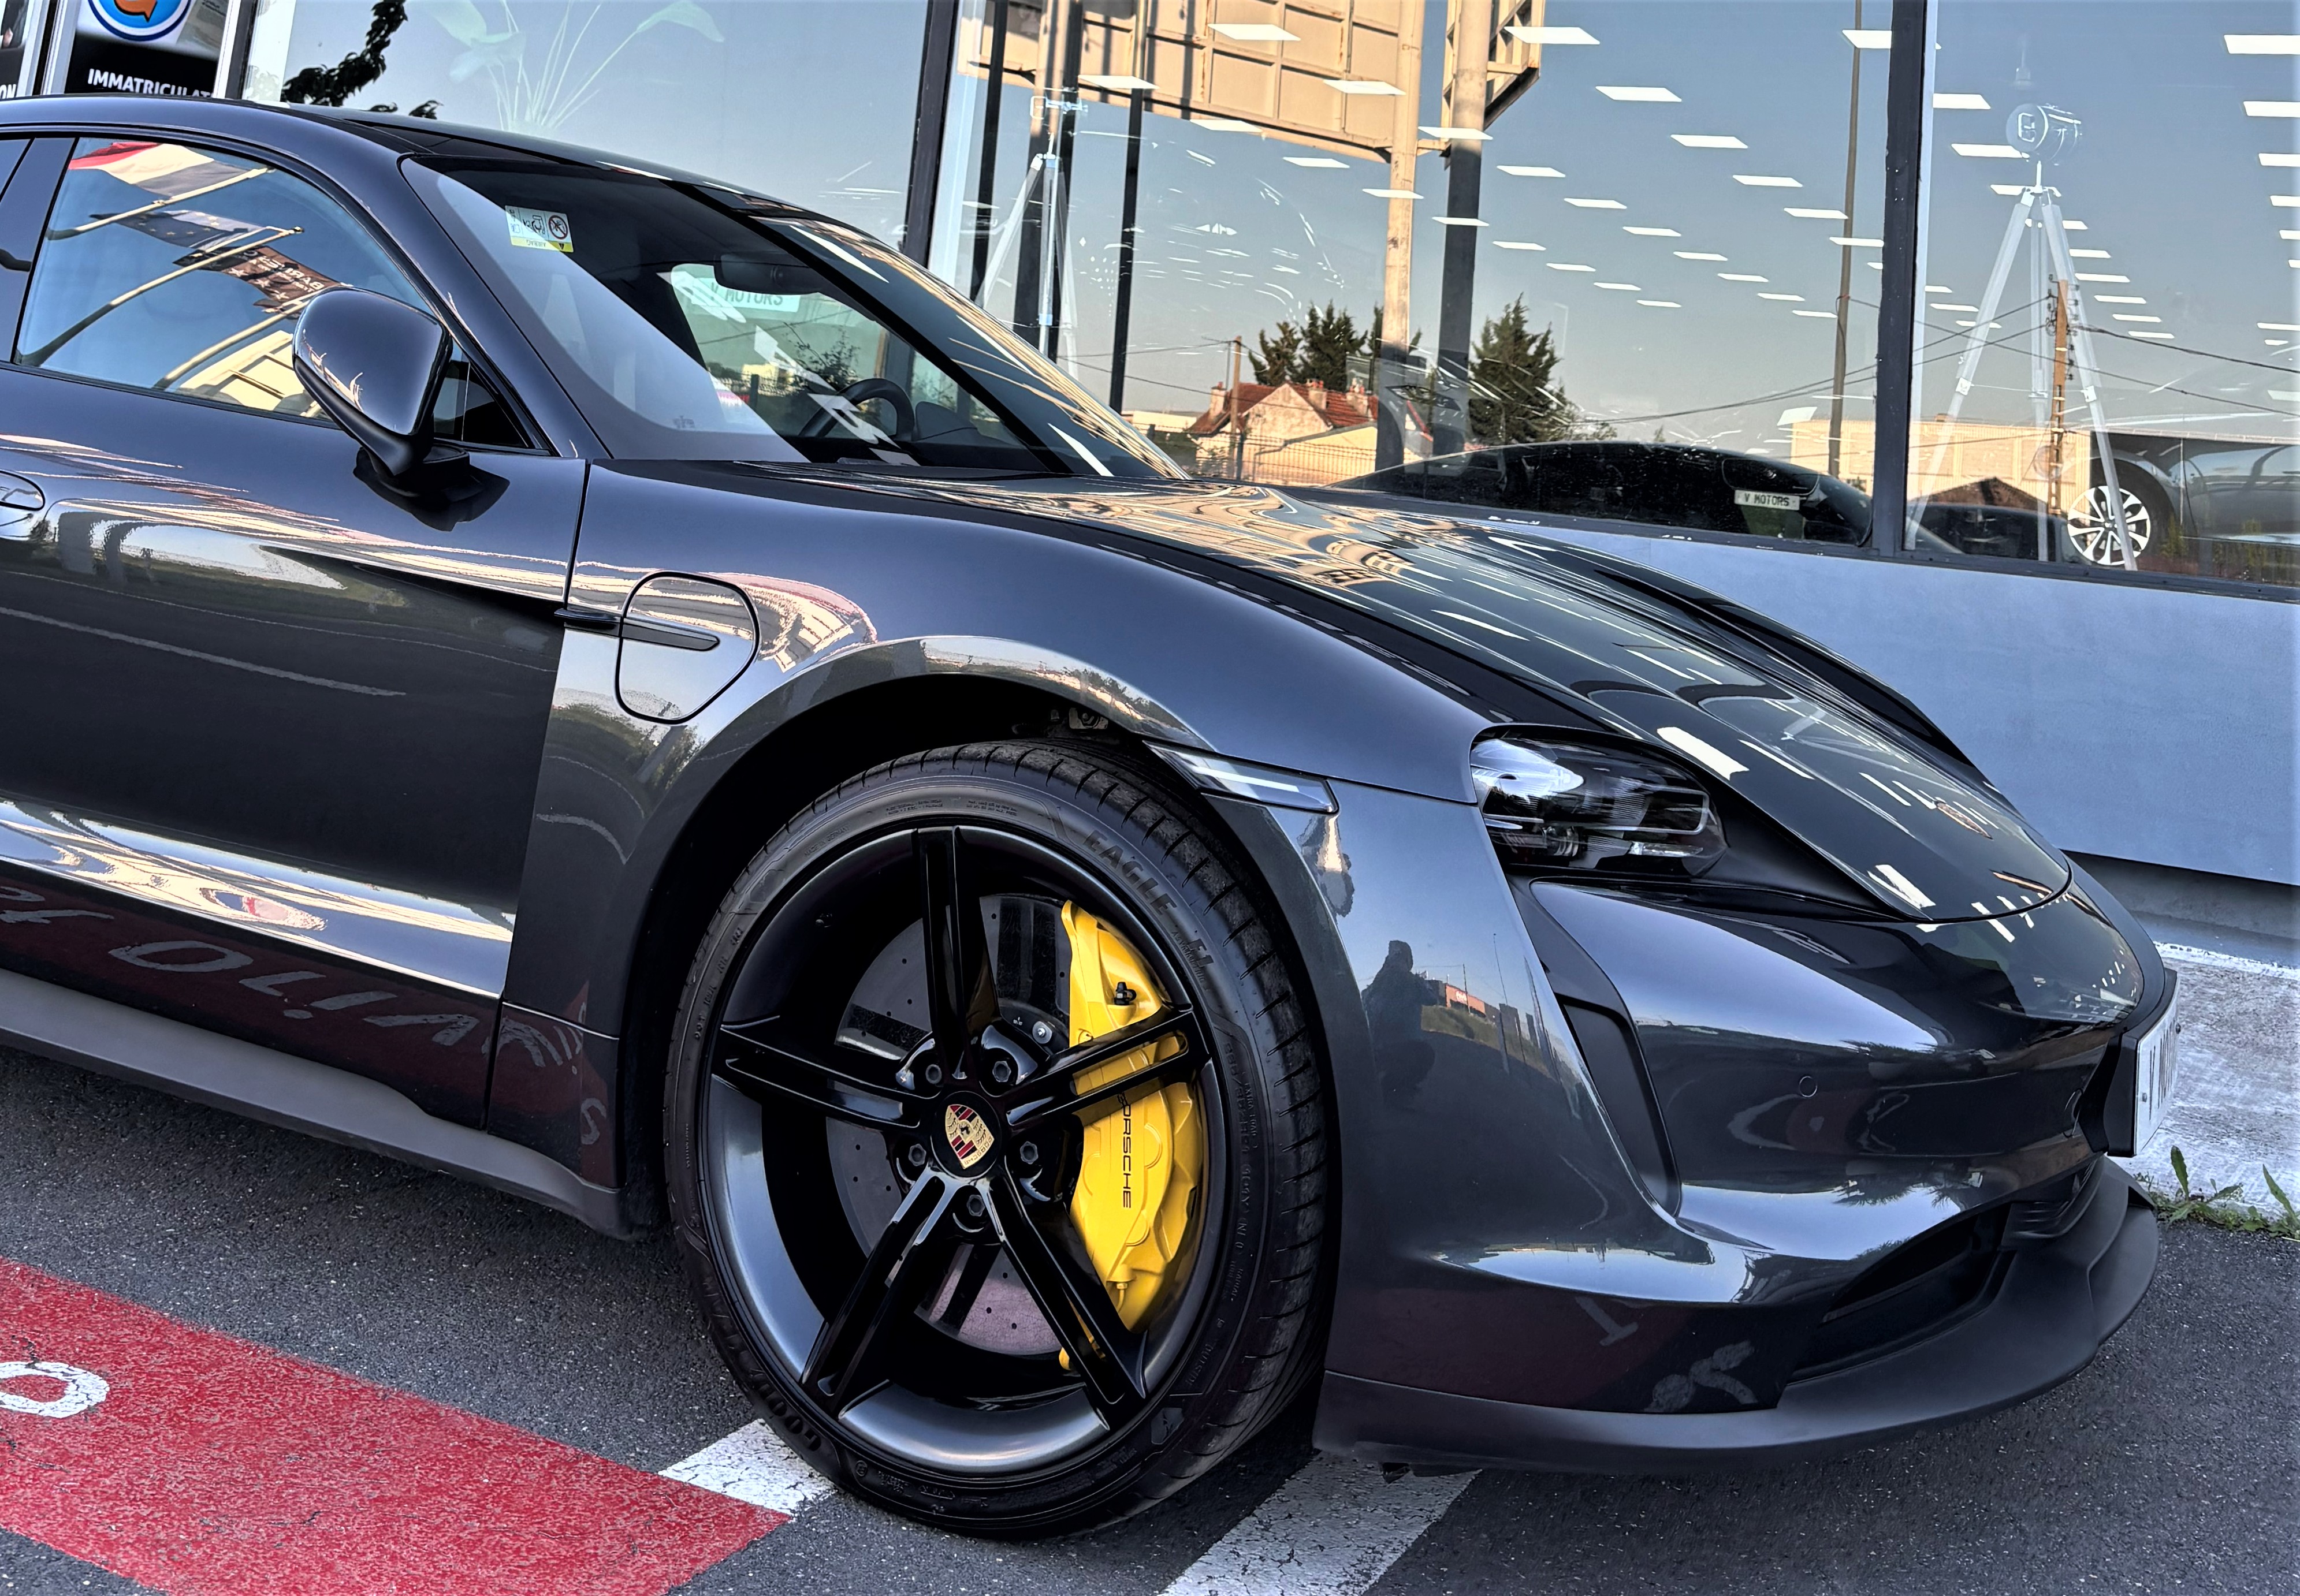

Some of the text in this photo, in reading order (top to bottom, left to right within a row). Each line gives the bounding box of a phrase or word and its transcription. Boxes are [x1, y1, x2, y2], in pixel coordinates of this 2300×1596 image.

[1745, 493, 1789, 506] V MOTORS
[1083, 830, 1214, 968] EAGLE F1
